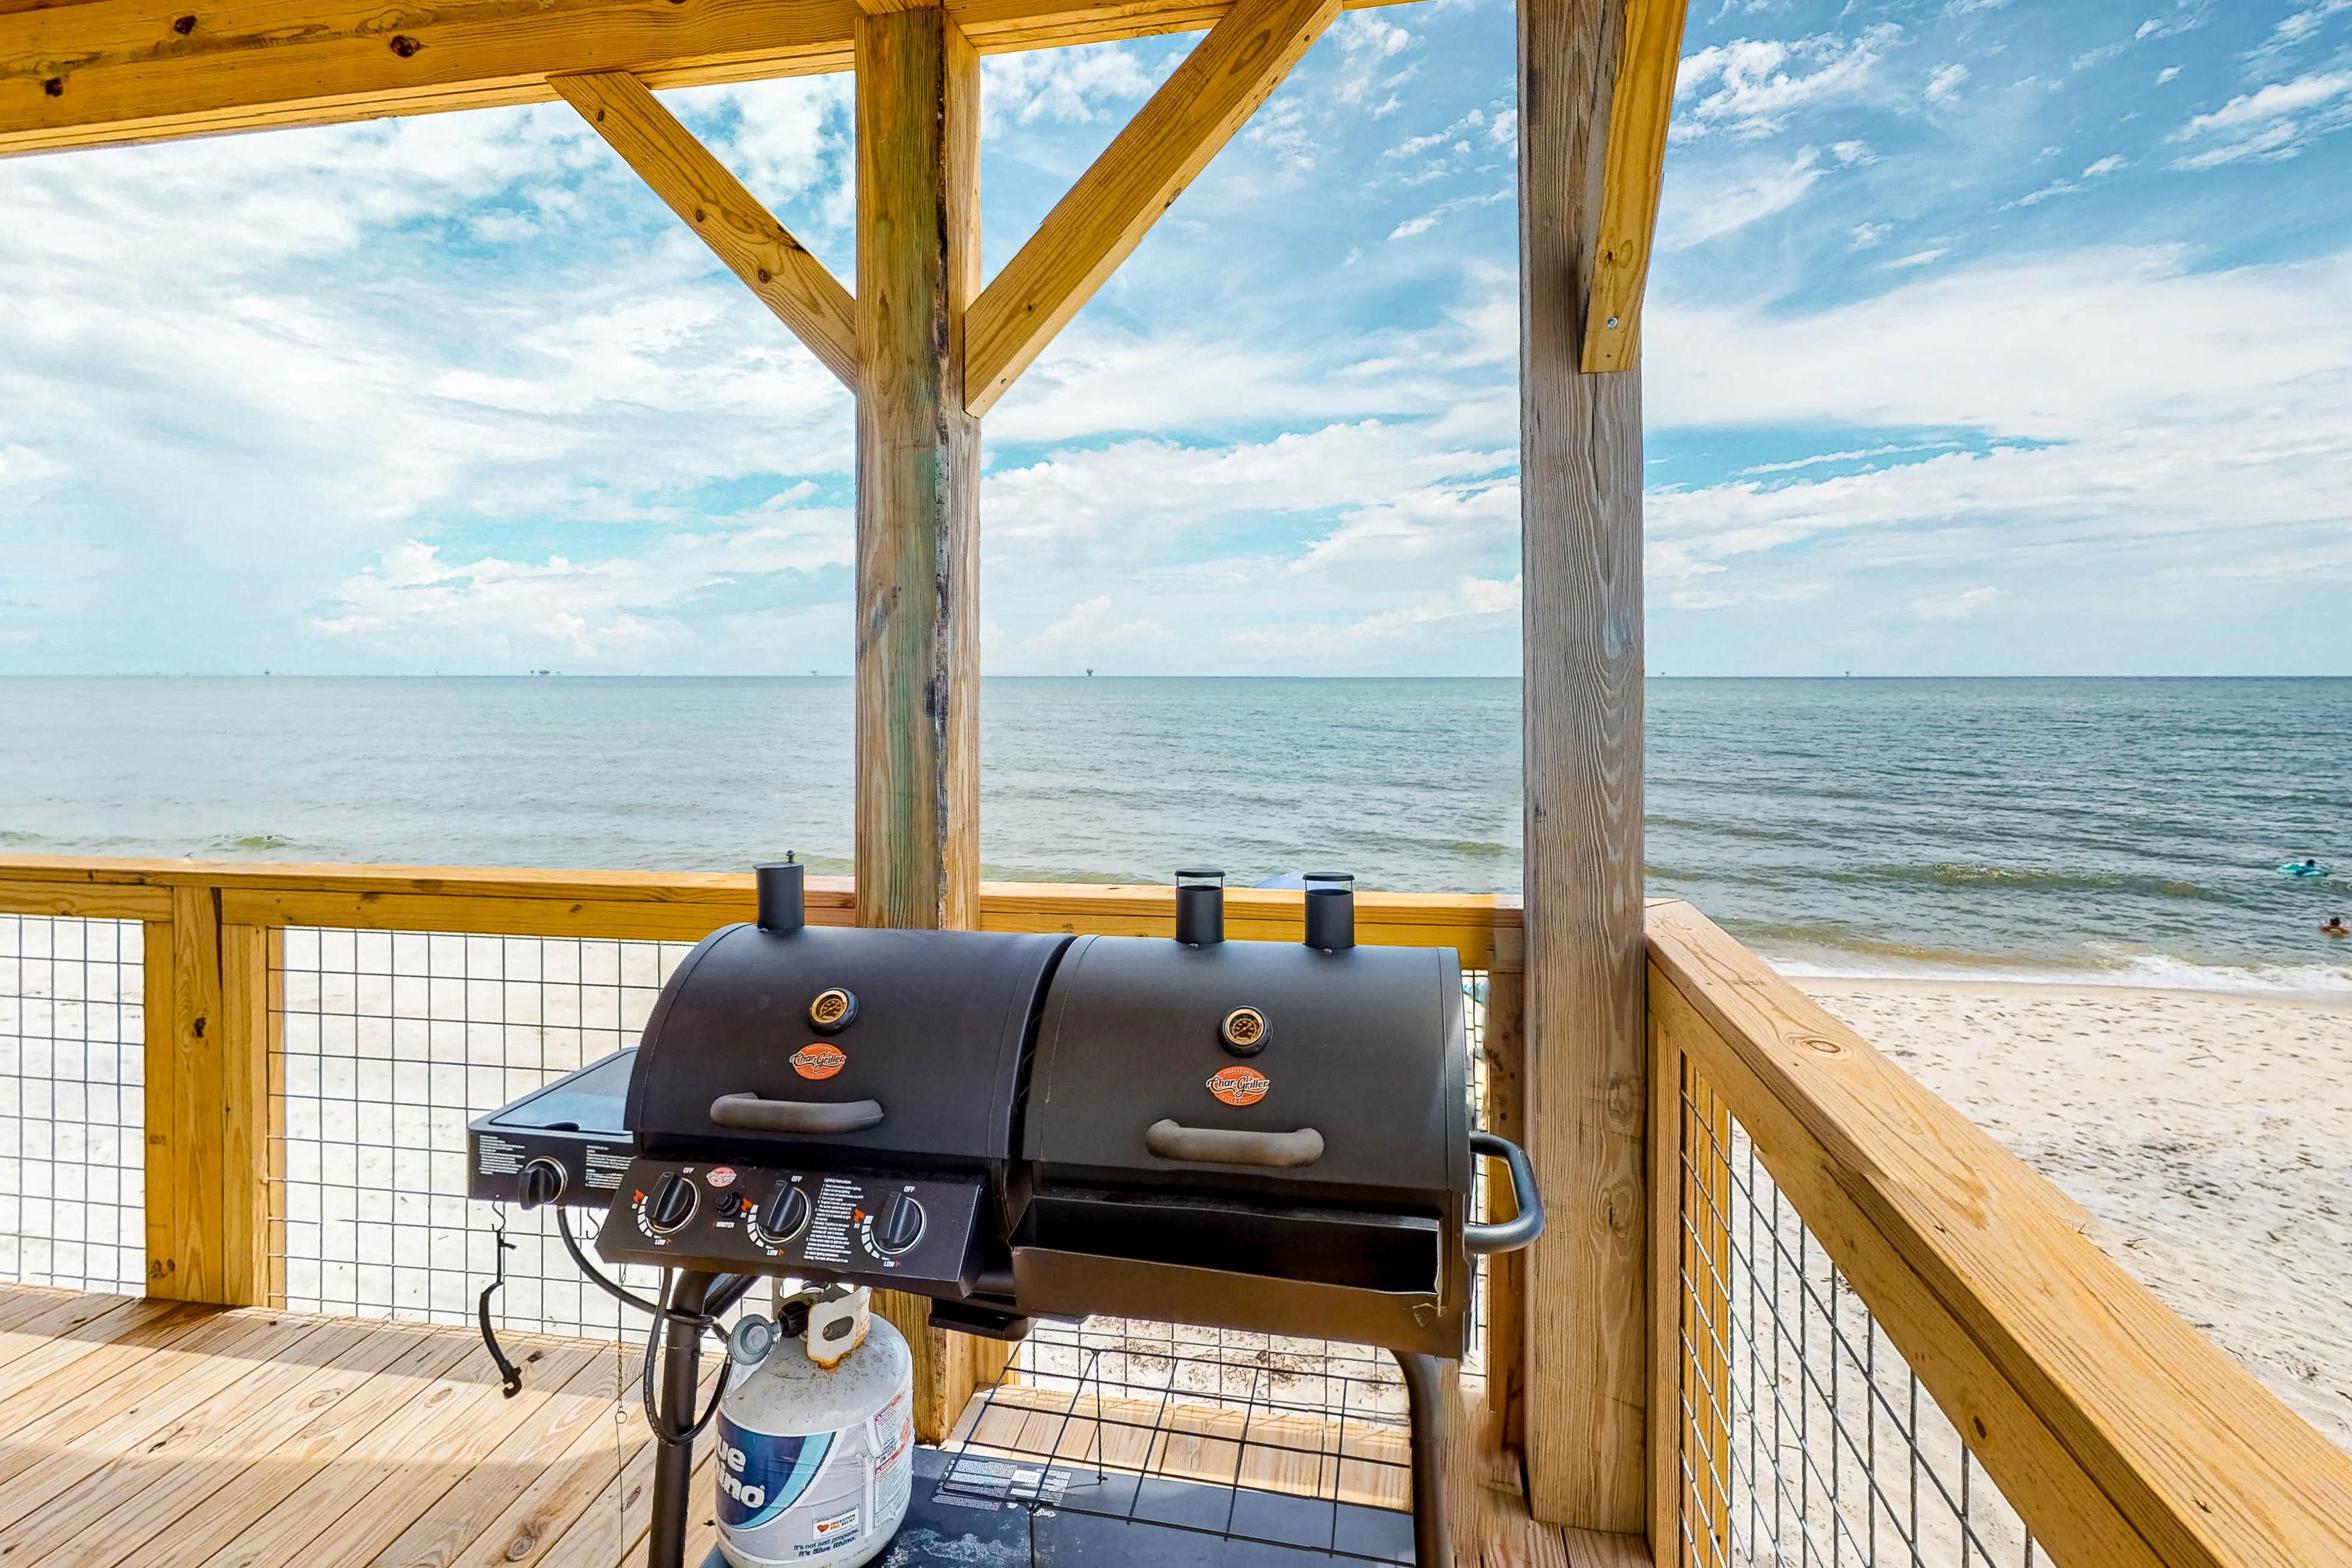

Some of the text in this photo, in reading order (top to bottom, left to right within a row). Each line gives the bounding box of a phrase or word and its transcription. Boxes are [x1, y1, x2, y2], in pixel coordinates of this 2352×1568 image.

[789, 1051, 847, 1073] Char-Griller
[1206, 1075, 1270, 1098] Char-Griller
[813, 1546, 831, 1555] Blue
